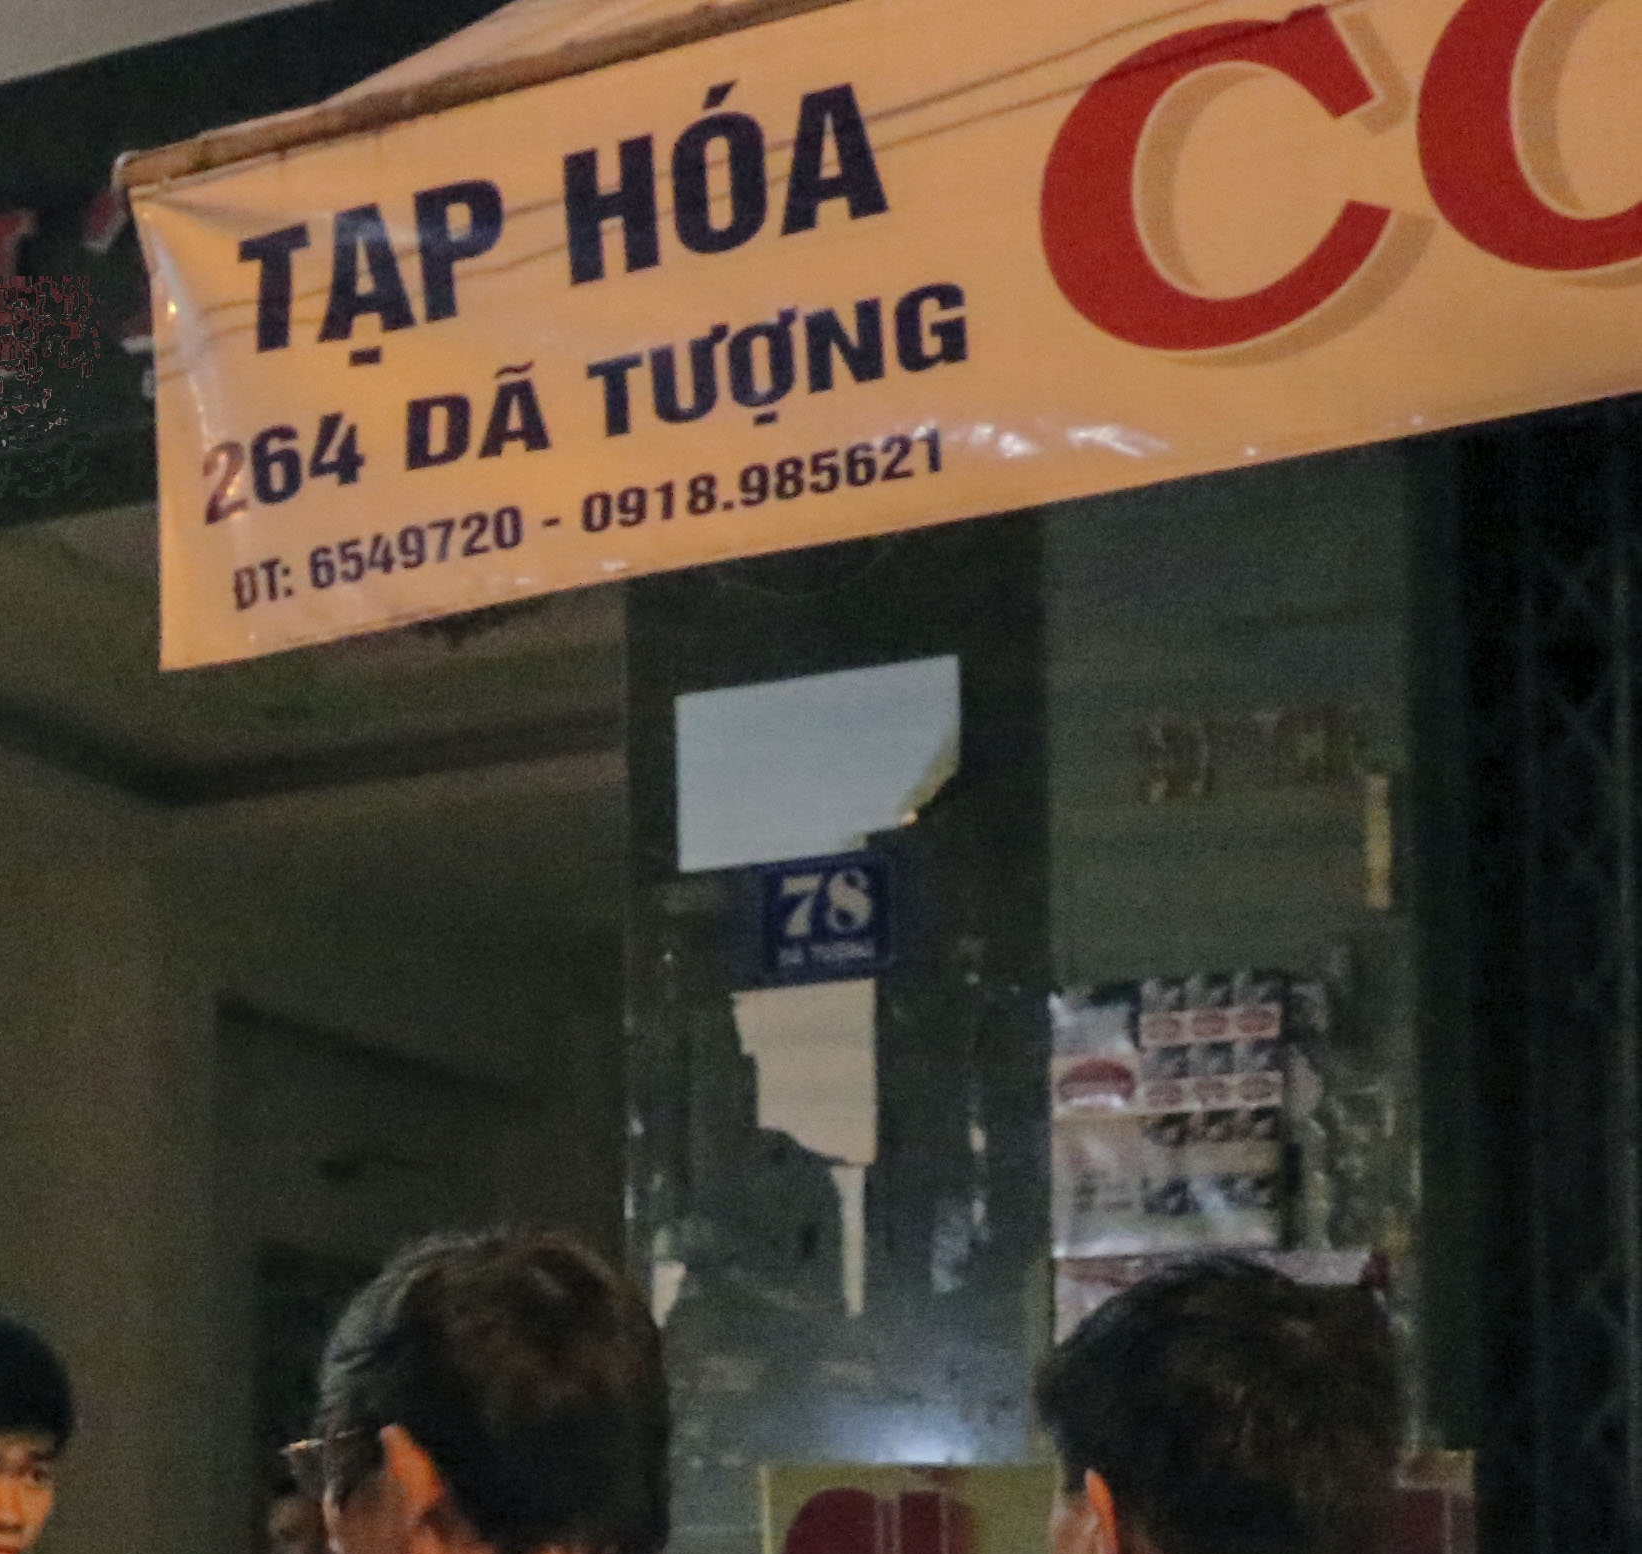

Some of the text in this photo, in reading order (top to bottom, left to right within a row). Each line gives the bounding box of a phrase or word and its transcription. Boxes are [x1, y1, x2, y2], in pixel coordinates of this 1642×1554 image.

[238, 81, 888, 367] TẠP HÓA
[202, 282, 970, 525] 264 DÃ TƯỢNG
[309, 506, 521, 590] 6549720
[581, 429, 943, 534] 0918.985621
[782, 866, 872, 938] 78
